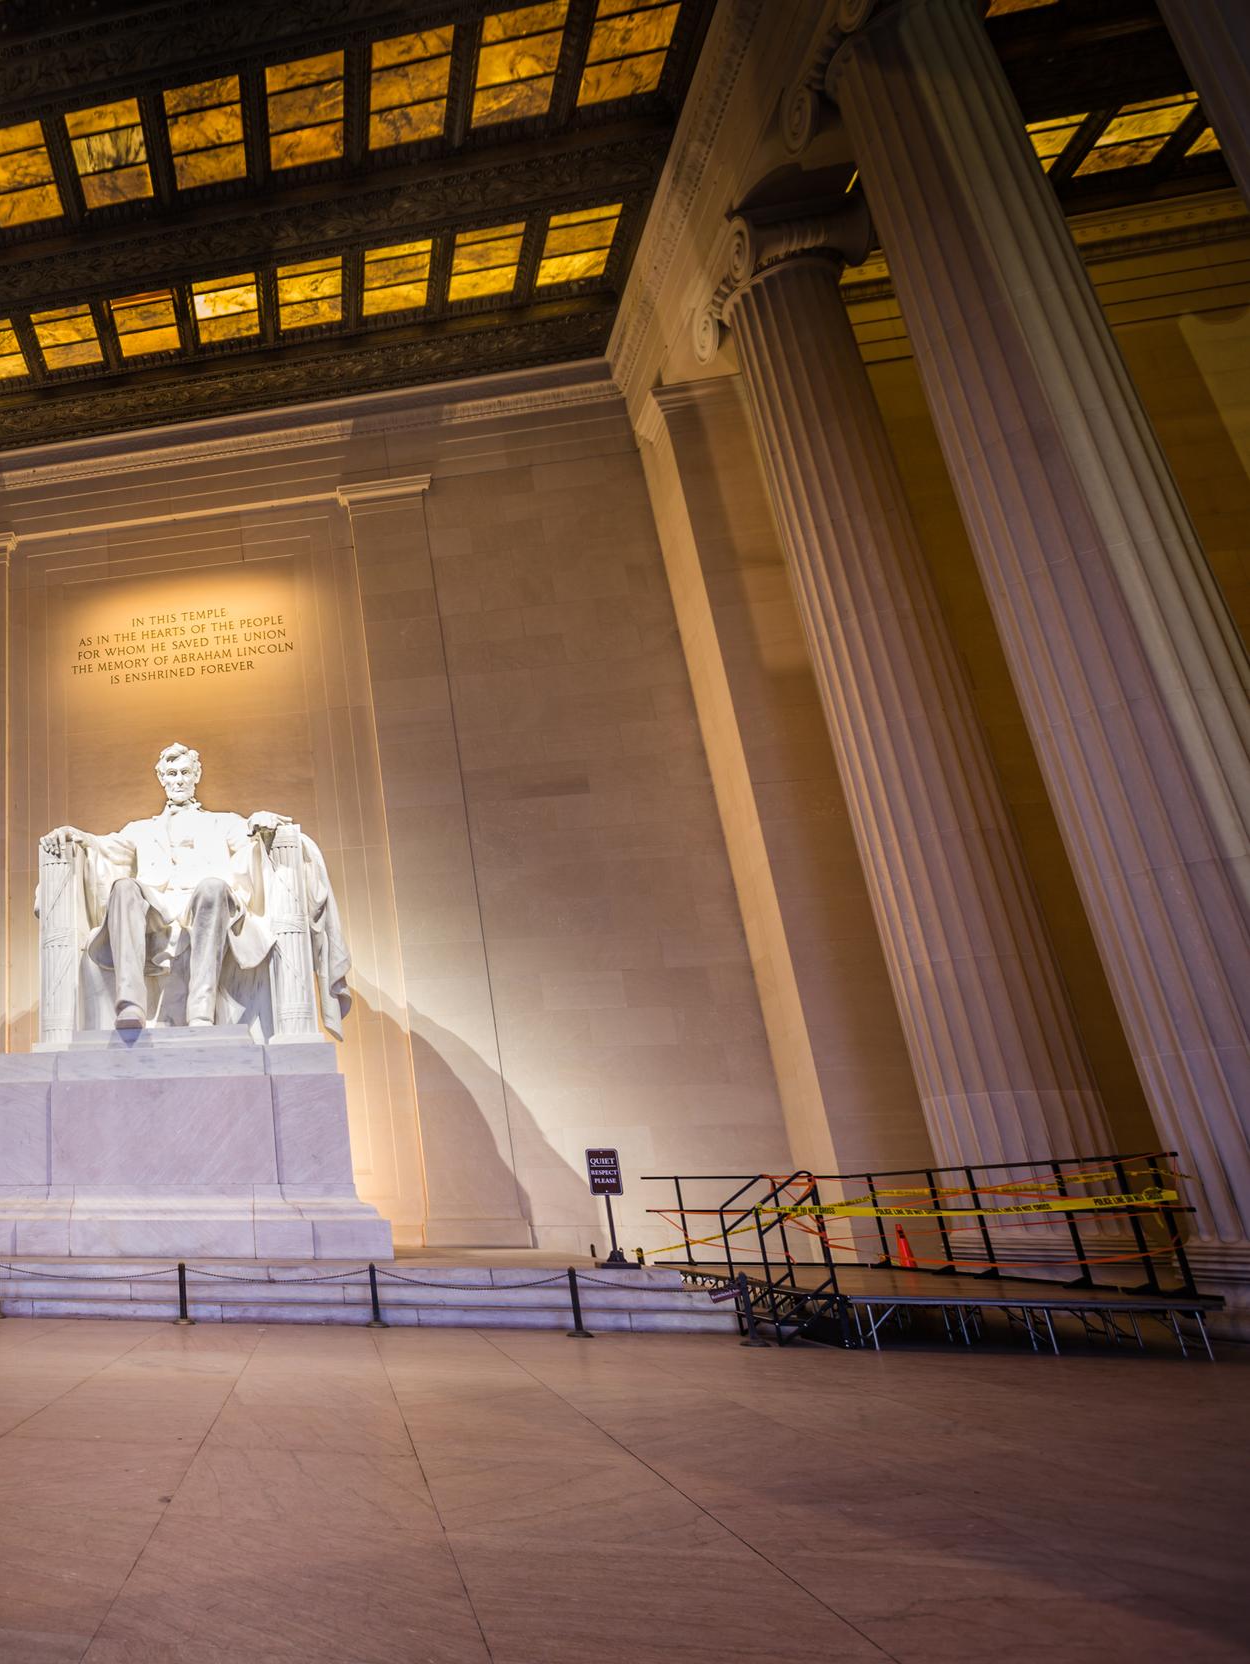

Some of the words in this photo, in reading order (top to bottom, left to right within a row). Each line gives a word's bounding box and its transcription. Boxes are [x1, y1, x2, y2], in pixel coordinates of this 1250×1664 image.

[132, 618, 144, 627] IN
[149, 614, 176, 625] THIS
[181, 608, 226, 621] TEMPLE
[78, 637, 92, 647] AS
[97, 635, 109, 644] IN
[114, 632, 136, 642] THE
[141, 627, 186, 640] HEARTS
[191, 624, 206, 634] OF
[211, 621, 234, 632] THE
[240, 615, 283, 628] PEOPLE
[78, 649, 100, 661] FOR
[105, 645, 145, 656] WHOM
[152, 642, 166, 652] HE
[172, 638, 209, 650] SAVED
[214, 634, 238, 645] THE
[244, 628, 286, 642] UNION
[71, 664, 93, 674] THE
[98, 658, 149, 672] MEMORY
[154, 656, 168, 666] OF
[173, 649, 232, 663] ABRAHAM
[237, 642, 294, 657] LINCOLN
[111, 674, 120, 684] IS
[126, 667, 195, 682] ENSHRINED
[201, 660, 254, 674] FOREVER
[590, 1157, 615, 1165] QUIET
[1093, 1198, 1113, 1206] POLICE
